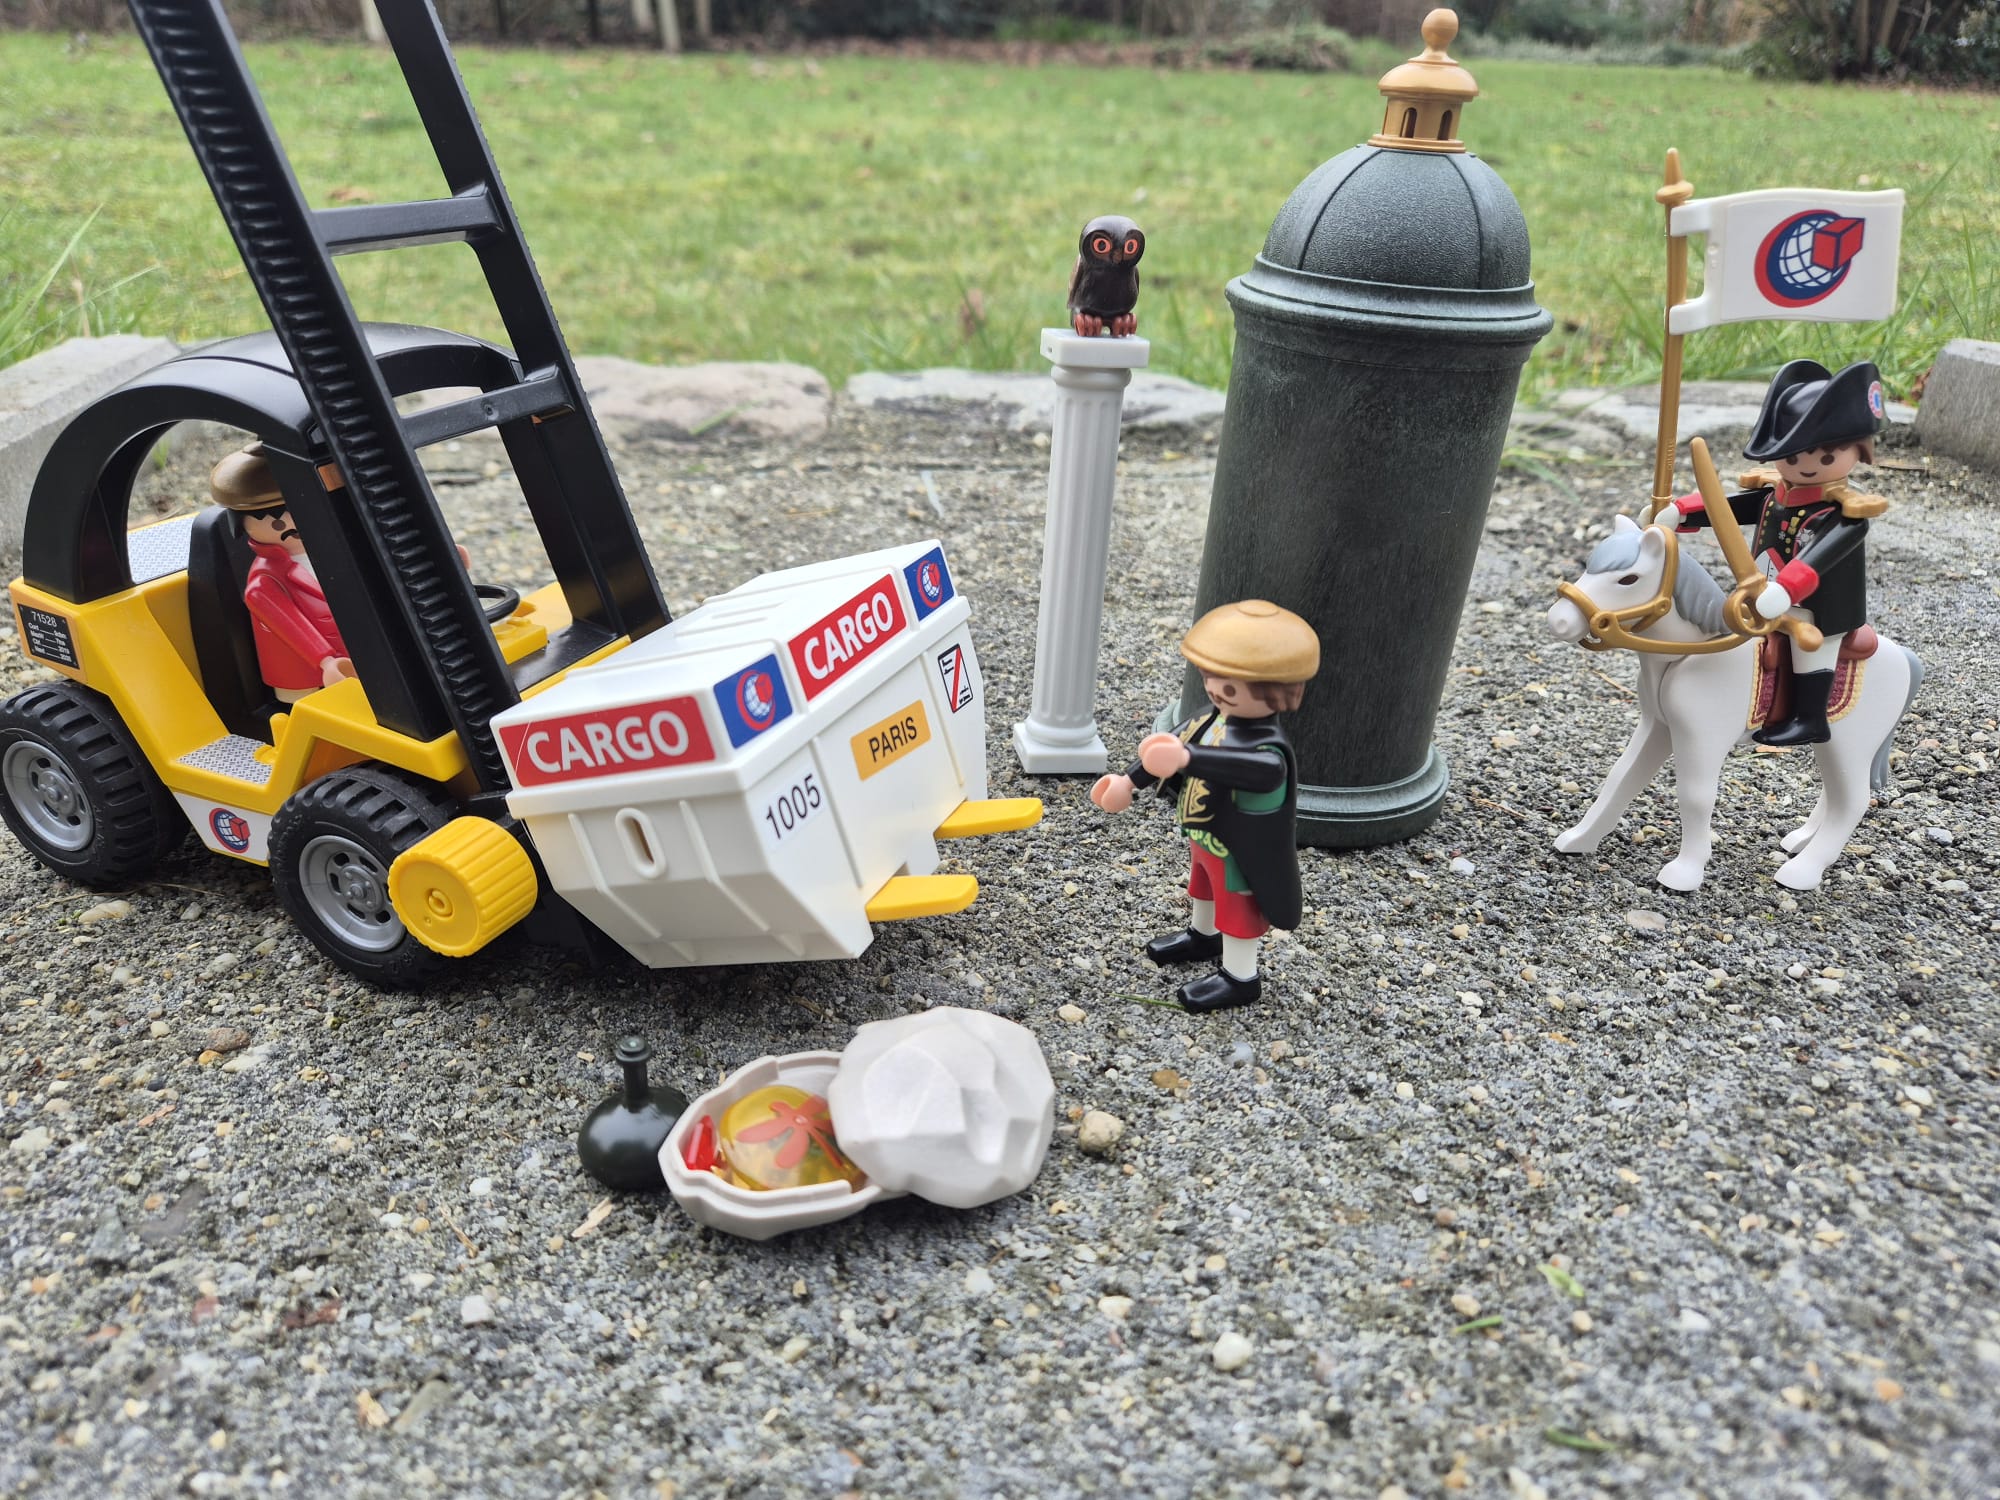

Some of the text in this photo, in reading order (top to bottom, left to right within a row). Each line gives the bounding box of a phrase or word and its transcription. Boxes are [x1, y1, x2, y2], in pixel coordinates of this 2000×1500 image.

[31, 611, 57, 628] 71528
[804, 591, 894, 680] CARGO
[527, 710, 689, 774] CARGO
[868, 716, 918, 763] PARIS
[766, 774, 822, 840] 1005
